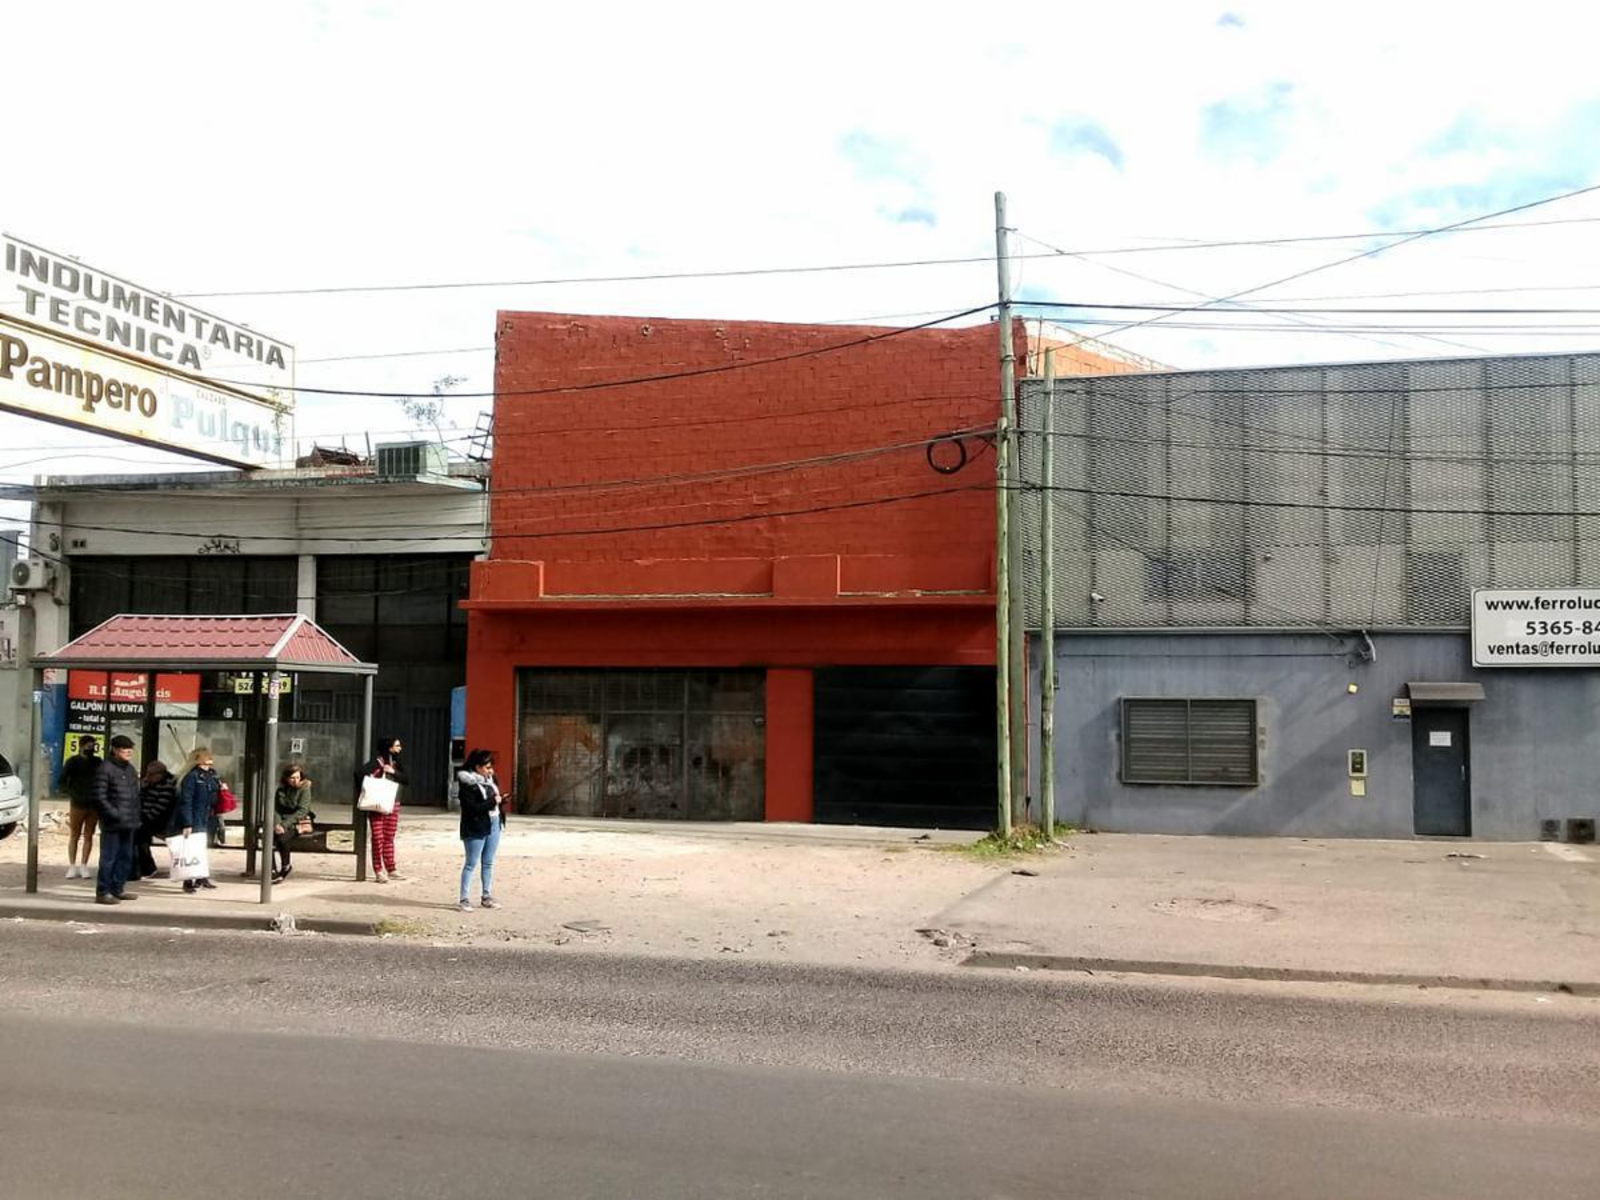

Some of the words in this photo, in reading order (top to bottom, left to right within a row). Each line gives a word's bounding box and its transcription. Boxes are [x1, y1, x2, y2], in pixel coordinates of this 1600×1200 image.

[5, 242, 286, 370] INDUMENTARIA
[17, 284, 202, 370] TECNICA
[0, 333, 158, 418] Pampero
[116, 703, 145, 714] VENTA
